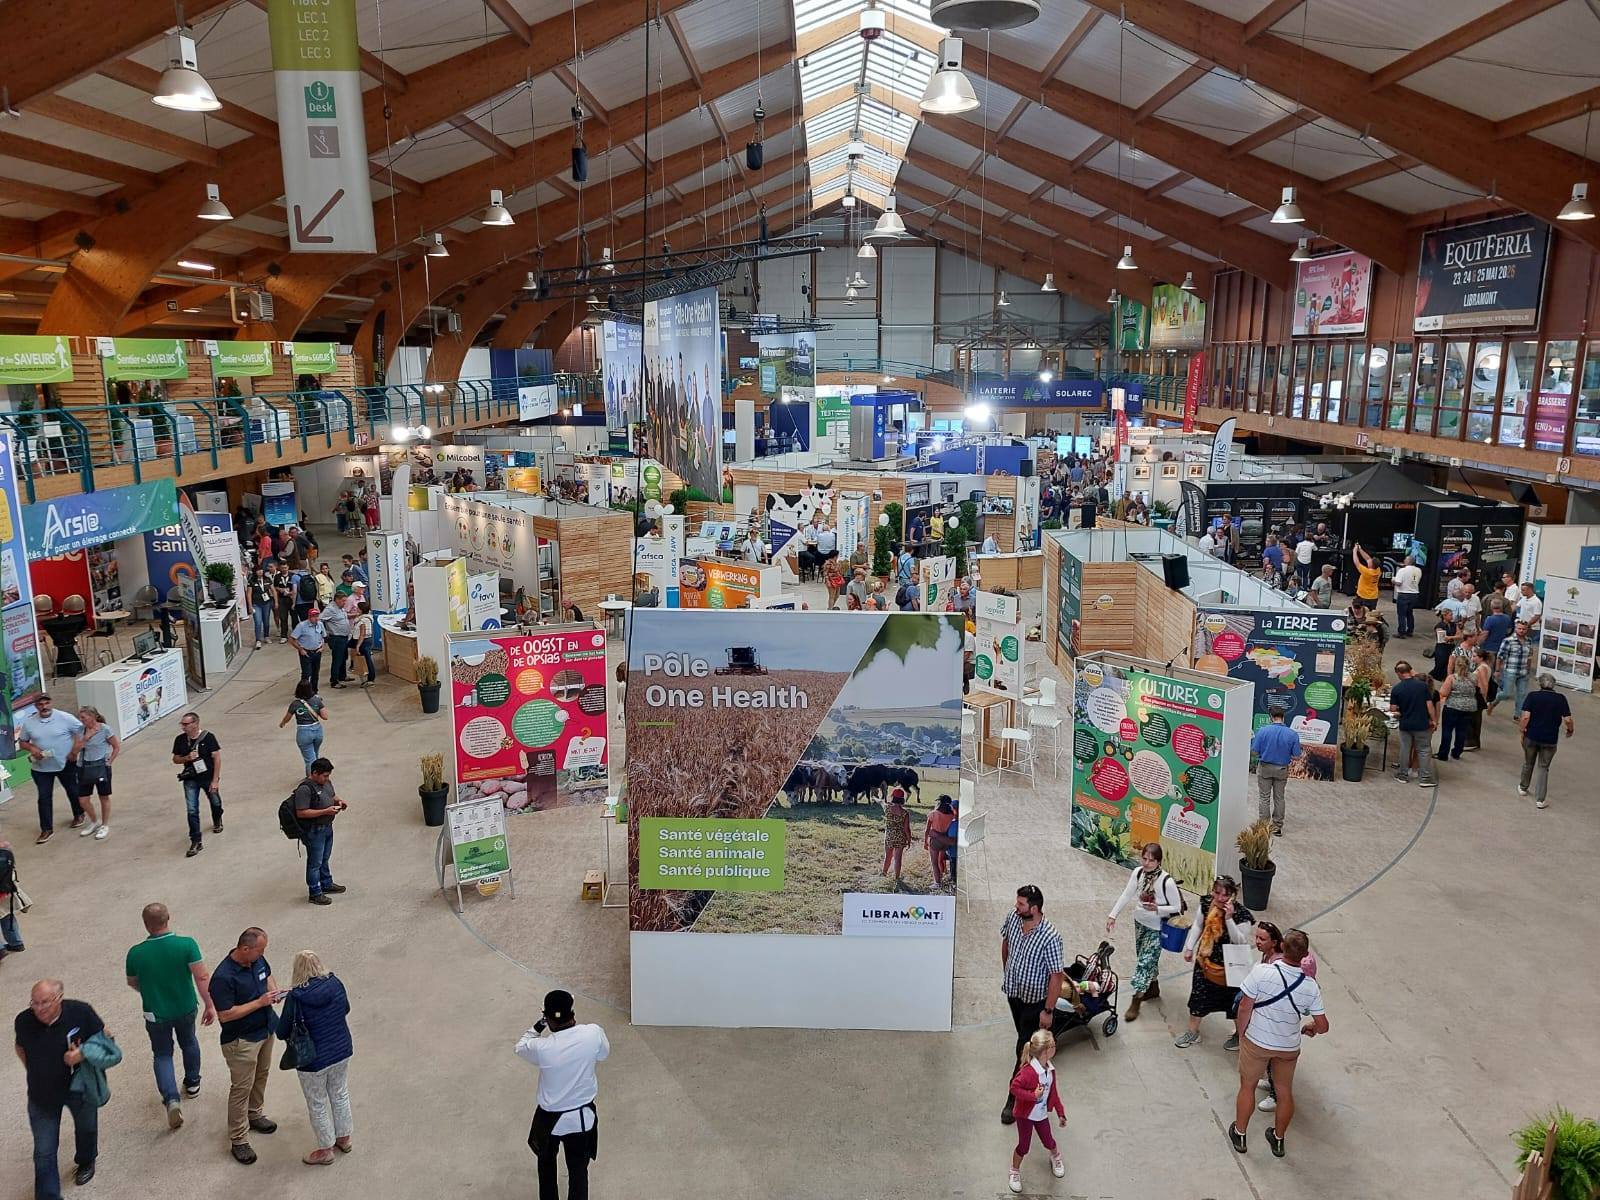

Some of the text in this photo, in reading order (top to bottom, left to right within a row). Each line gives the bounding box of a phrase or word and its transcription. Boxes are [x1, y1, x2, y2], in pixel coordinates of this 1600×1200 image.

[297, 11, 328, 24] LEC 1
[299, 29, 330, 41] LEC 2
[300, 47, 331, 59] LEC 3
[309, 102, 333, 113] Desk
[1486, 266, 1498, 280] MAI
[1463, 291, 1498, 307] LIBRAMONT
[14, 353, 56, 366] SAVEURS
[116, 354, 141, 365] Sentier
[146, 353, 176, 364] SAVEURS
[980, 387, 1016, 395] LAITERIE
[446, 454, 481, 462] Milcobel
[641, 552, 664, 560] afsca
[1261, 615, 1318, 631] La TERRE
[510, 645, 521, 656] DE
[567, 641, 579, 651] EN
[513, 657, 524, 667] DE
[644, 652, 709, 677] Pôle
[136, 672, 162, 694] BIGAME
[645, 685, 808, 709] One Health
[1138, 677, 1199, 706] CULTURES
[659, 828, 769, 844] Santé végétale
[659, 846, 765, 860] Santé animale
[659, 863, 771, 879] Santé publique
